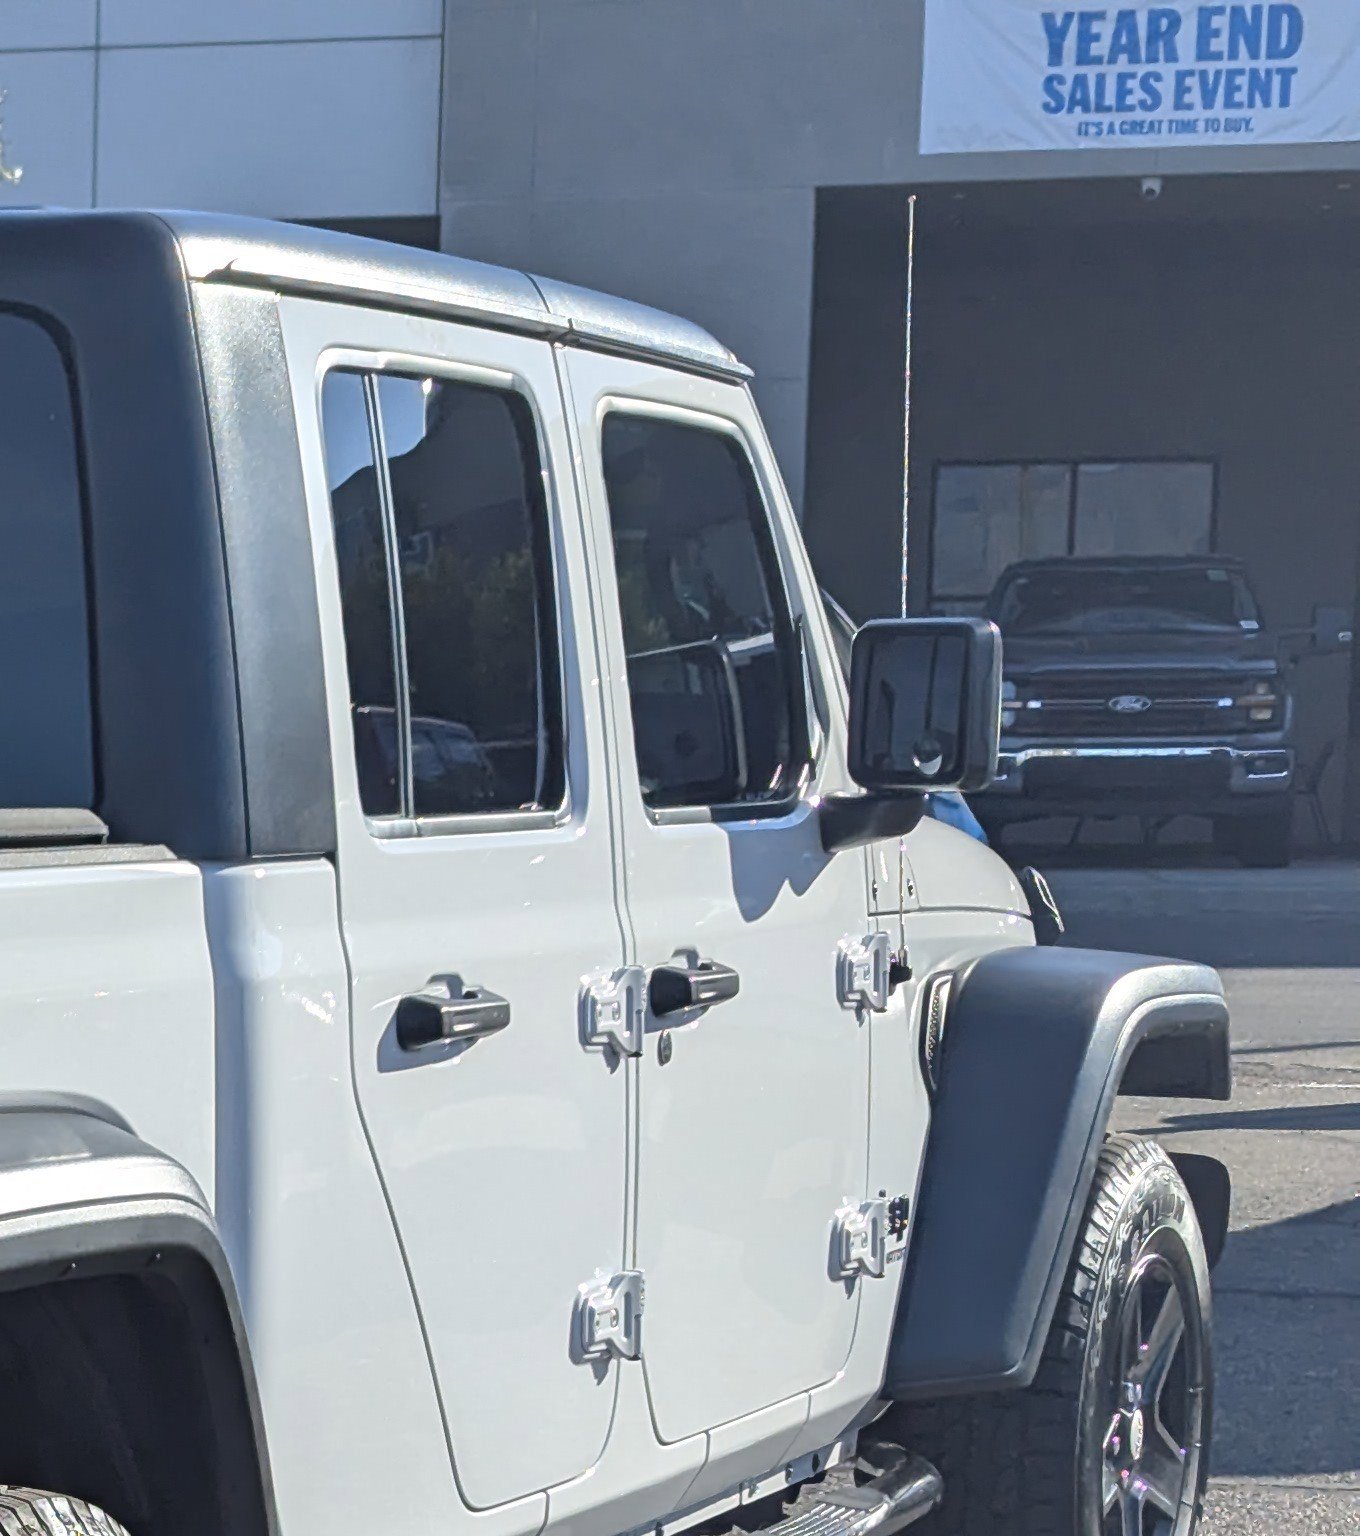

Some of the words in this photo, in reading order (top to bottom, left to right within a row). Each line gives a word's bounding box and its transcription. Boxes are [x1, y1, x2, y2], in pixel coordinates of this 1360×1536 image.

[1040, 7, 1181, 67] YEAR
[1195, 4, 1304, 62] END
[1042, 69, 1163, 114] SALES
[1173, 66, 1298, 111] EVENT
[1077, 121, 1104, 137] IT'S
[1106, 120, 1116, 136] A
[1119, 119, 1165, 136] GREAT
[1167, 118, 1201, 135] TIME
[1203, 118, 1221, 134] TO
